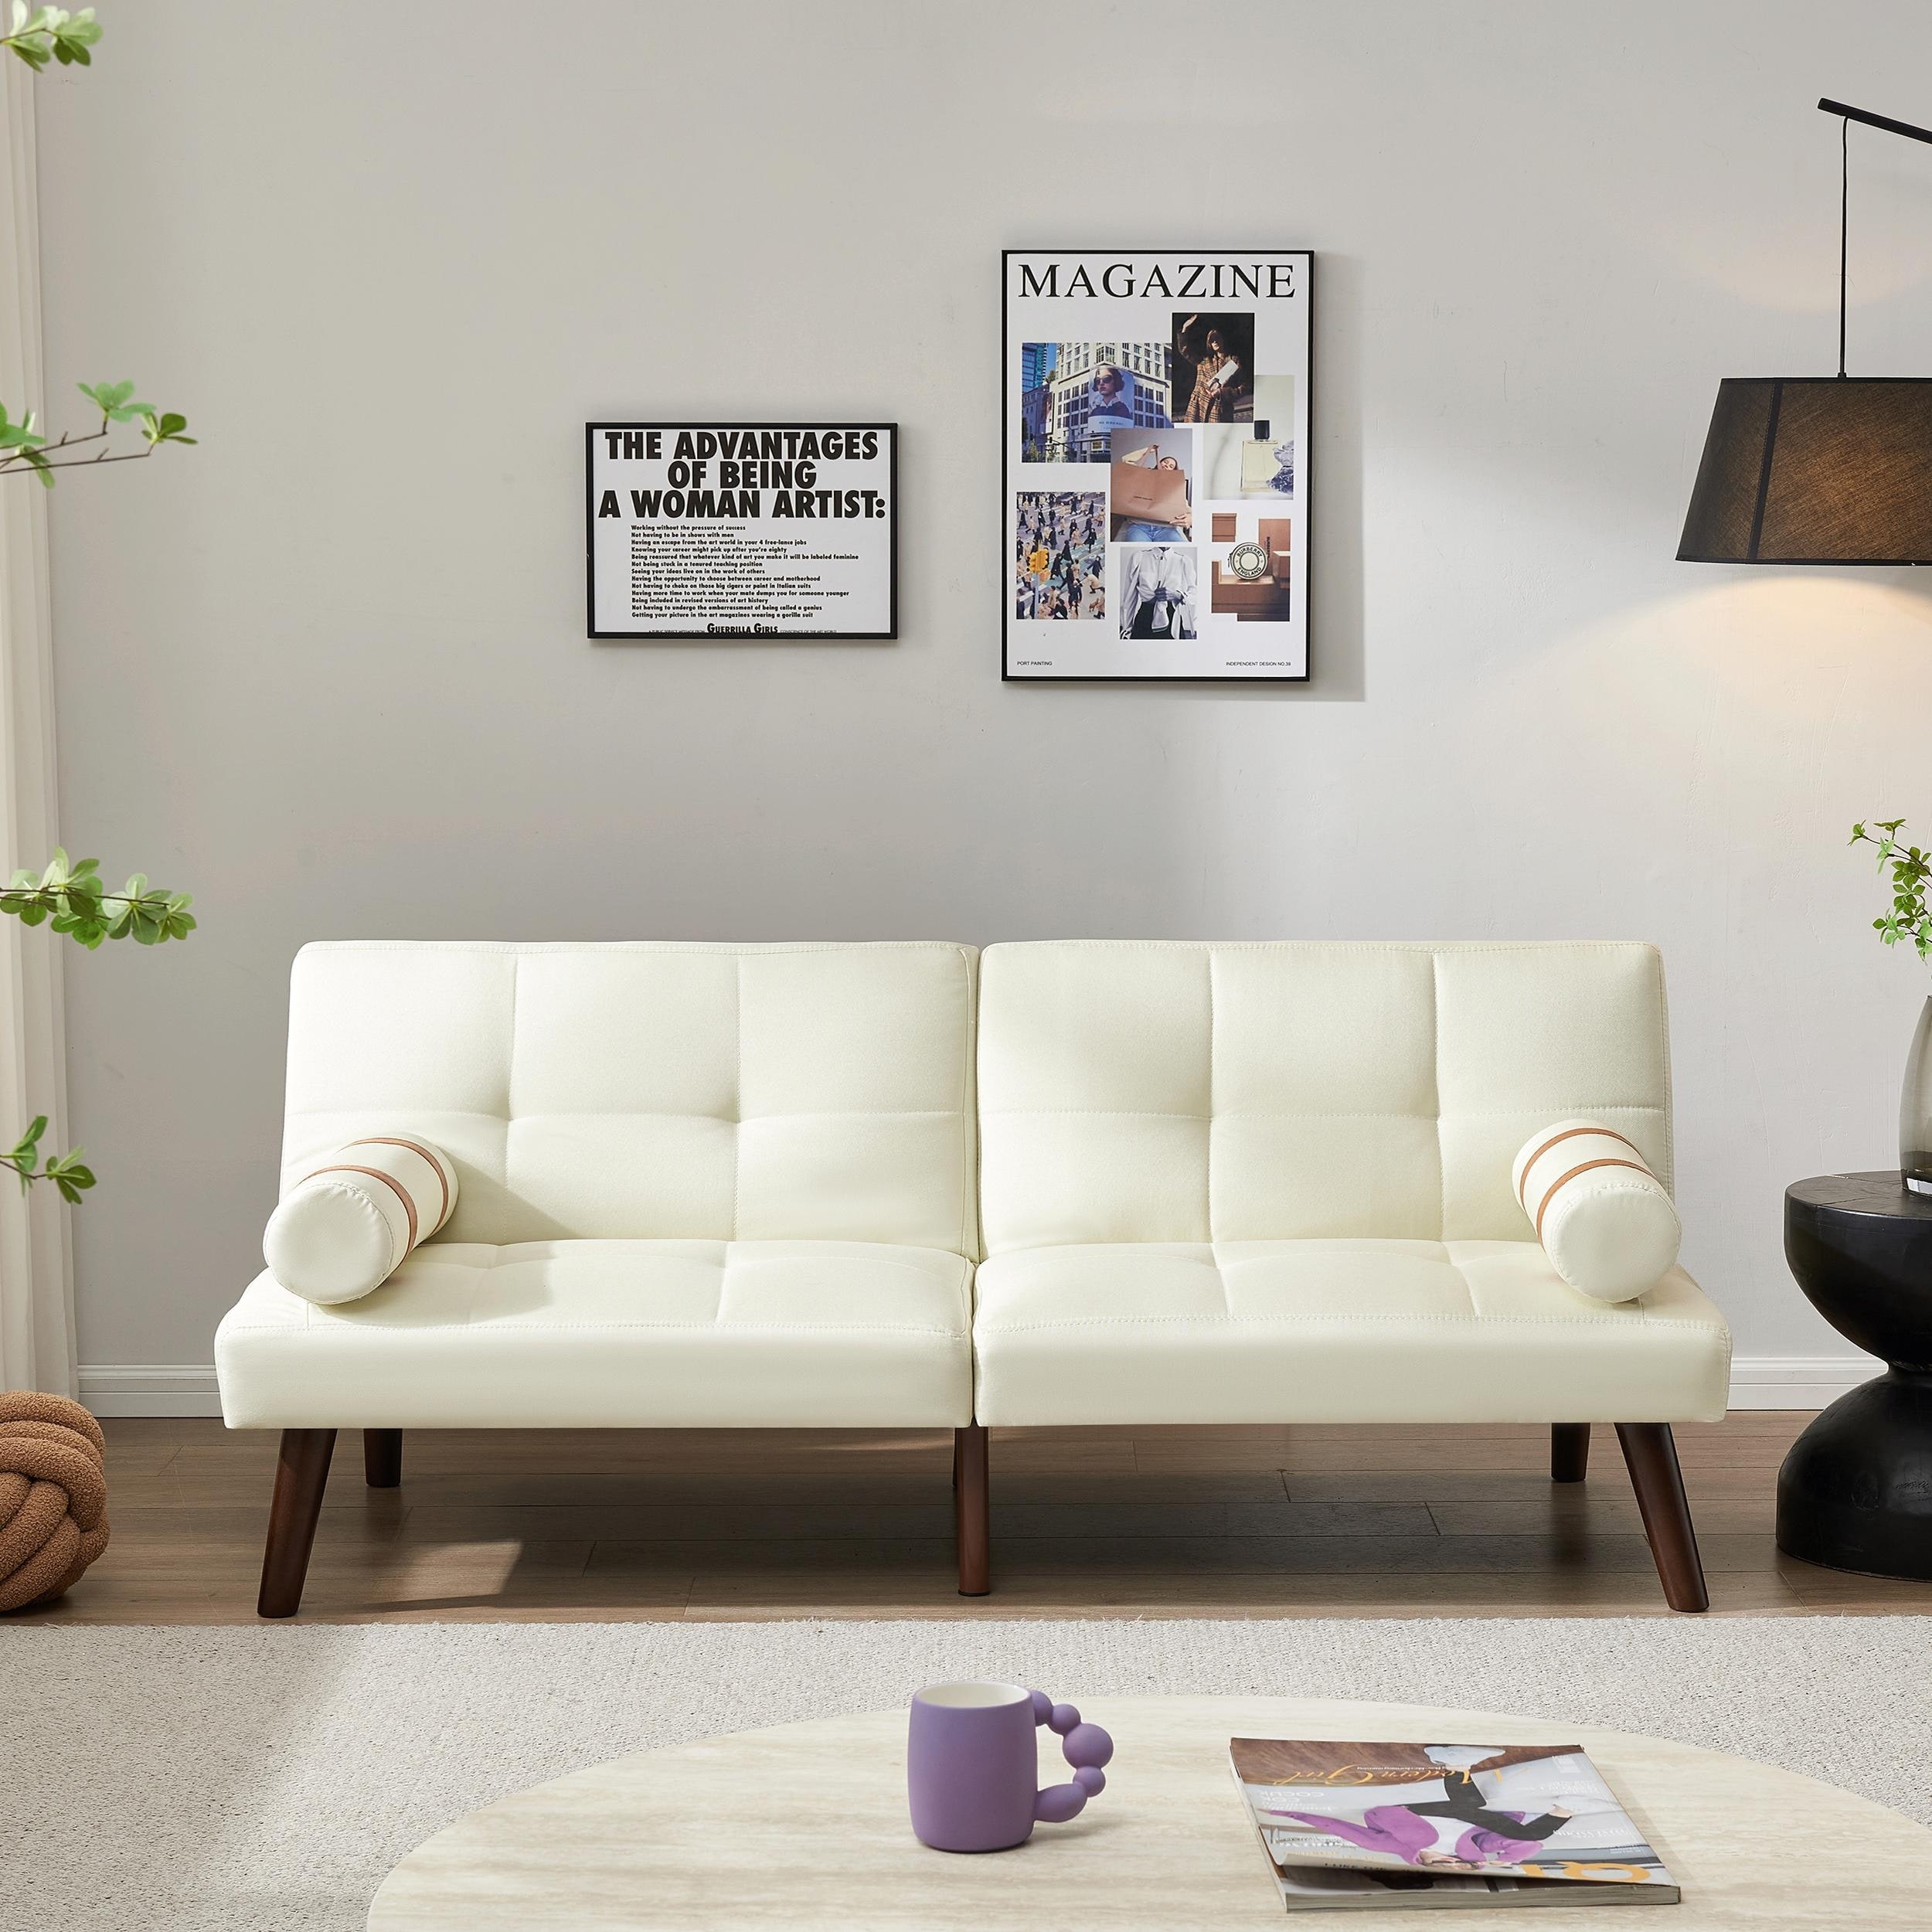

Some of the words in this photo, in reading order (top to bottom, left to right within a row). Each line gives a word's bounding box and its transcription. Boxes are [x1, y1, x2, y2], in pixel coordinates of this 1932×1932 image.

[1018, 264, 1295, 298] MAGAZINE
[605, 432, 662, 459] THE
[673, 432, 879, 460] ADVANTAGES
[668, 461, 707, 489] OF
[719, 461, 817, 489] BEING
[599, 490, 621, 518] A
[631, 490, 760, 519] WOMAN
[772, 490, 886, 519] ARTIST:
[1236, 546, 1262, 557] BURBERRY
[1237, 567, 1262, 576] ENGLAND
